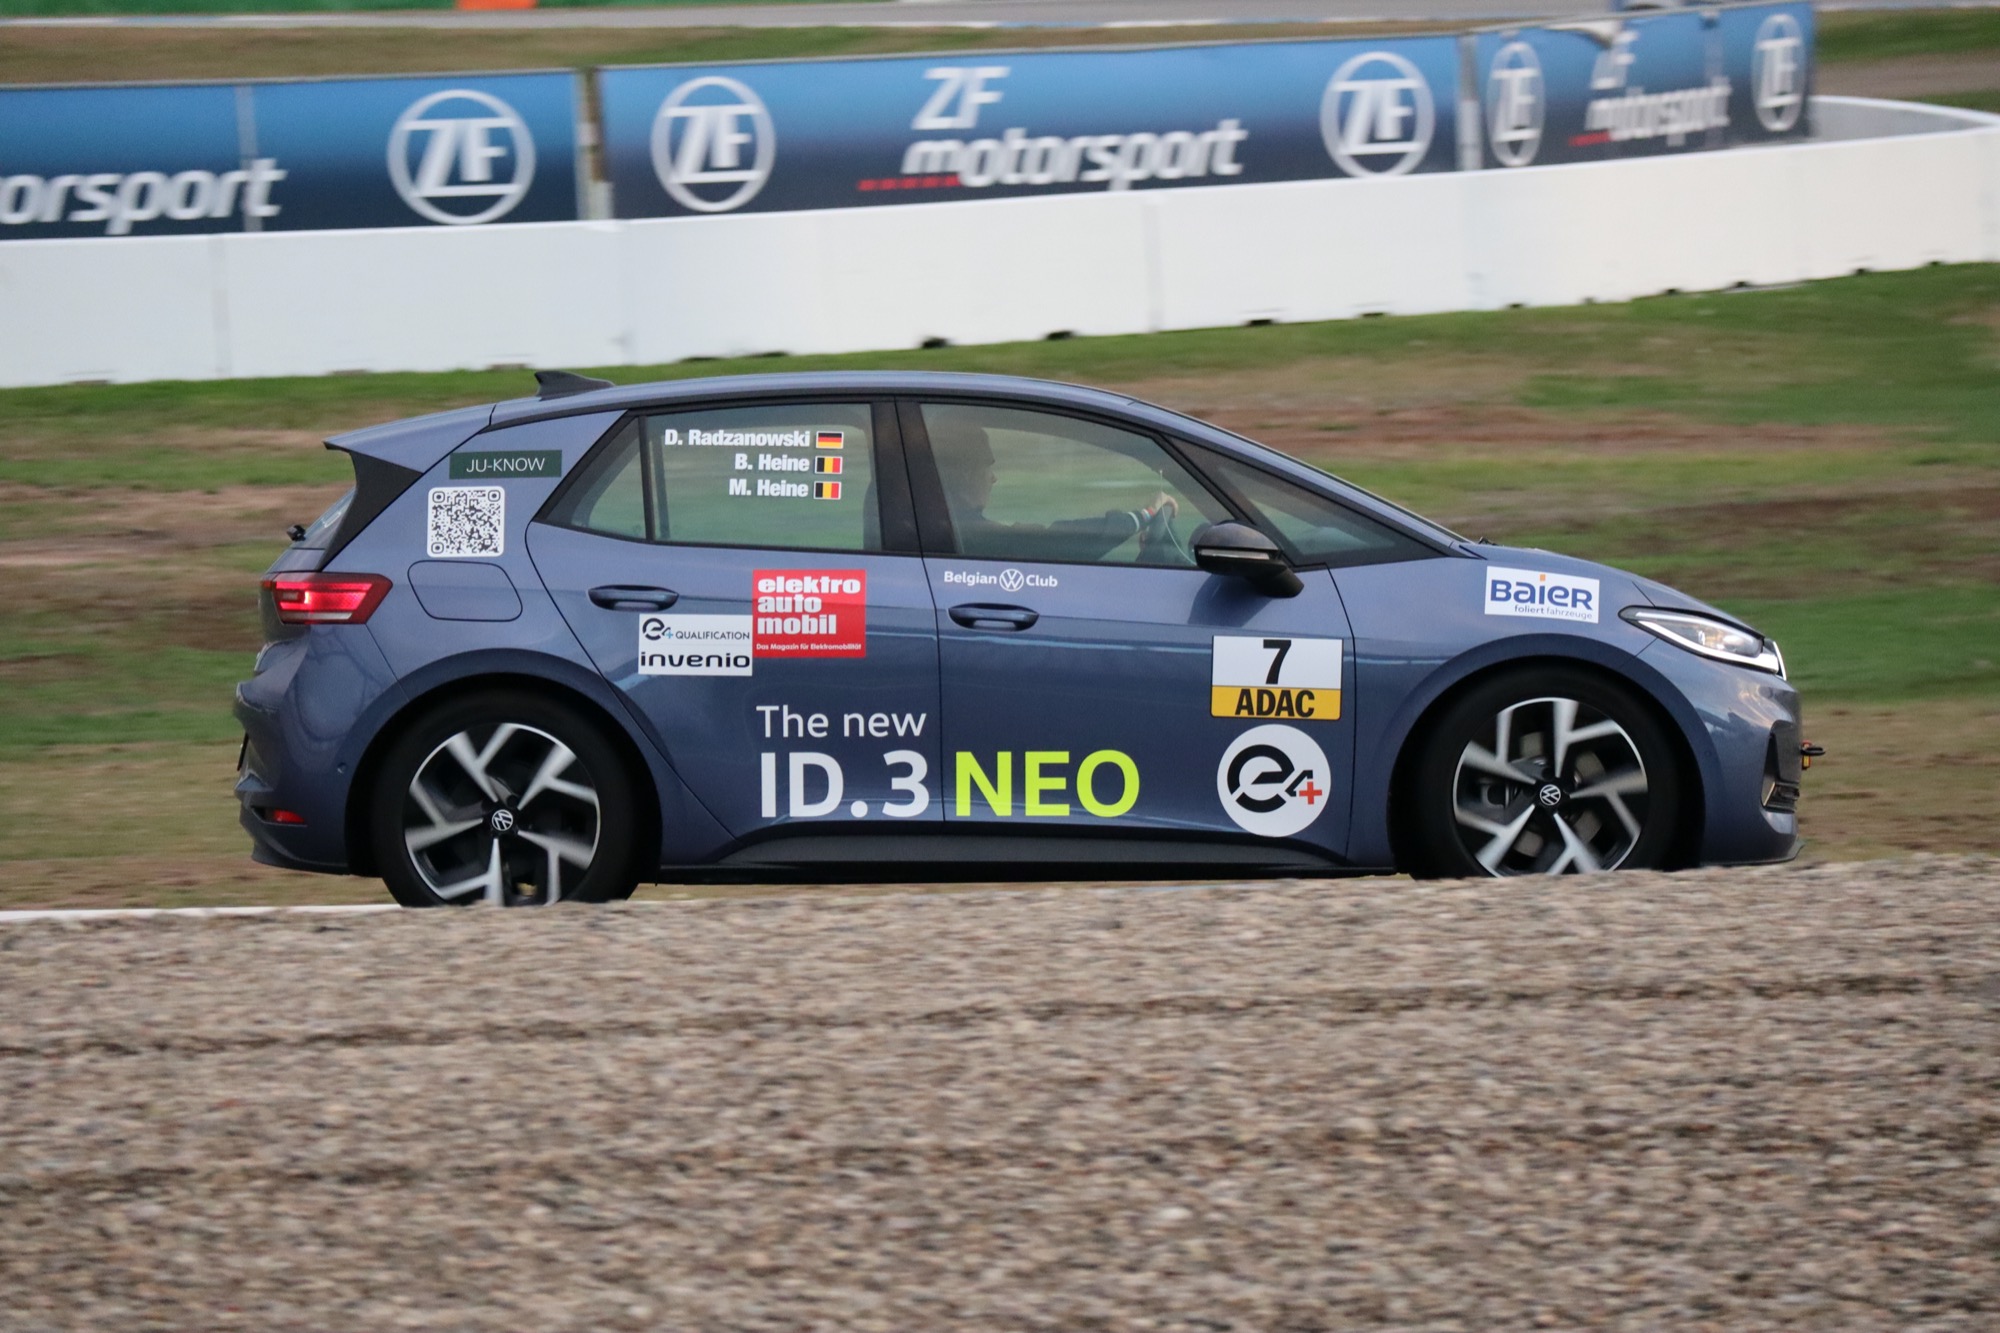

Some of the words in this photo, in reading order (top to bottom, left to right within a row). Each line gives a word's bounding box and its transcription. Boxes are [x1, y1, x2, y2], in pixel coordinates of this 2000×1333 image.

[911, 66, 1011, 130] ZF
[901, 118, 1248, 191] motorsport
[664, 428, 683, 446] D.
[688, 429, 811, 448] Radzanowski
[466, 457, 546, 473] JU-KNOW
[734, 453, 753, 471] B.
[758, 453, 810, 472] Heine
[728, 478, 751, 497] M.
[757, 479, 809, 498] Heine
[757, 576, 861, 594] elektro
[943, 571, 997, 586] Belgian
[1026, 574, 1058, 588] Club
[757, 594, 822, 613] auto
[1514, 605, 1544, 614] foliert
[1546, 606, 1593, 620] fahrzeuge
[757, 614, 836, 635] mobil
[675, 630, 750, 641] QUALIFICATION
[756, 643, 769, 651] Das
[771, 643, 799, 652] Magazin
[800, 643, 809, 651] für
[810, 643, 862, 651] Elektromobilität
[640, 651, 751, 668] invenio
[1263, 639, 1292, 685] 7
[1234, 688, 1315, 718] ADAC
[756, 704, 829, 738] The
[843, 712, 927, 737] new
[955, 749, 1140, 817] NEO
